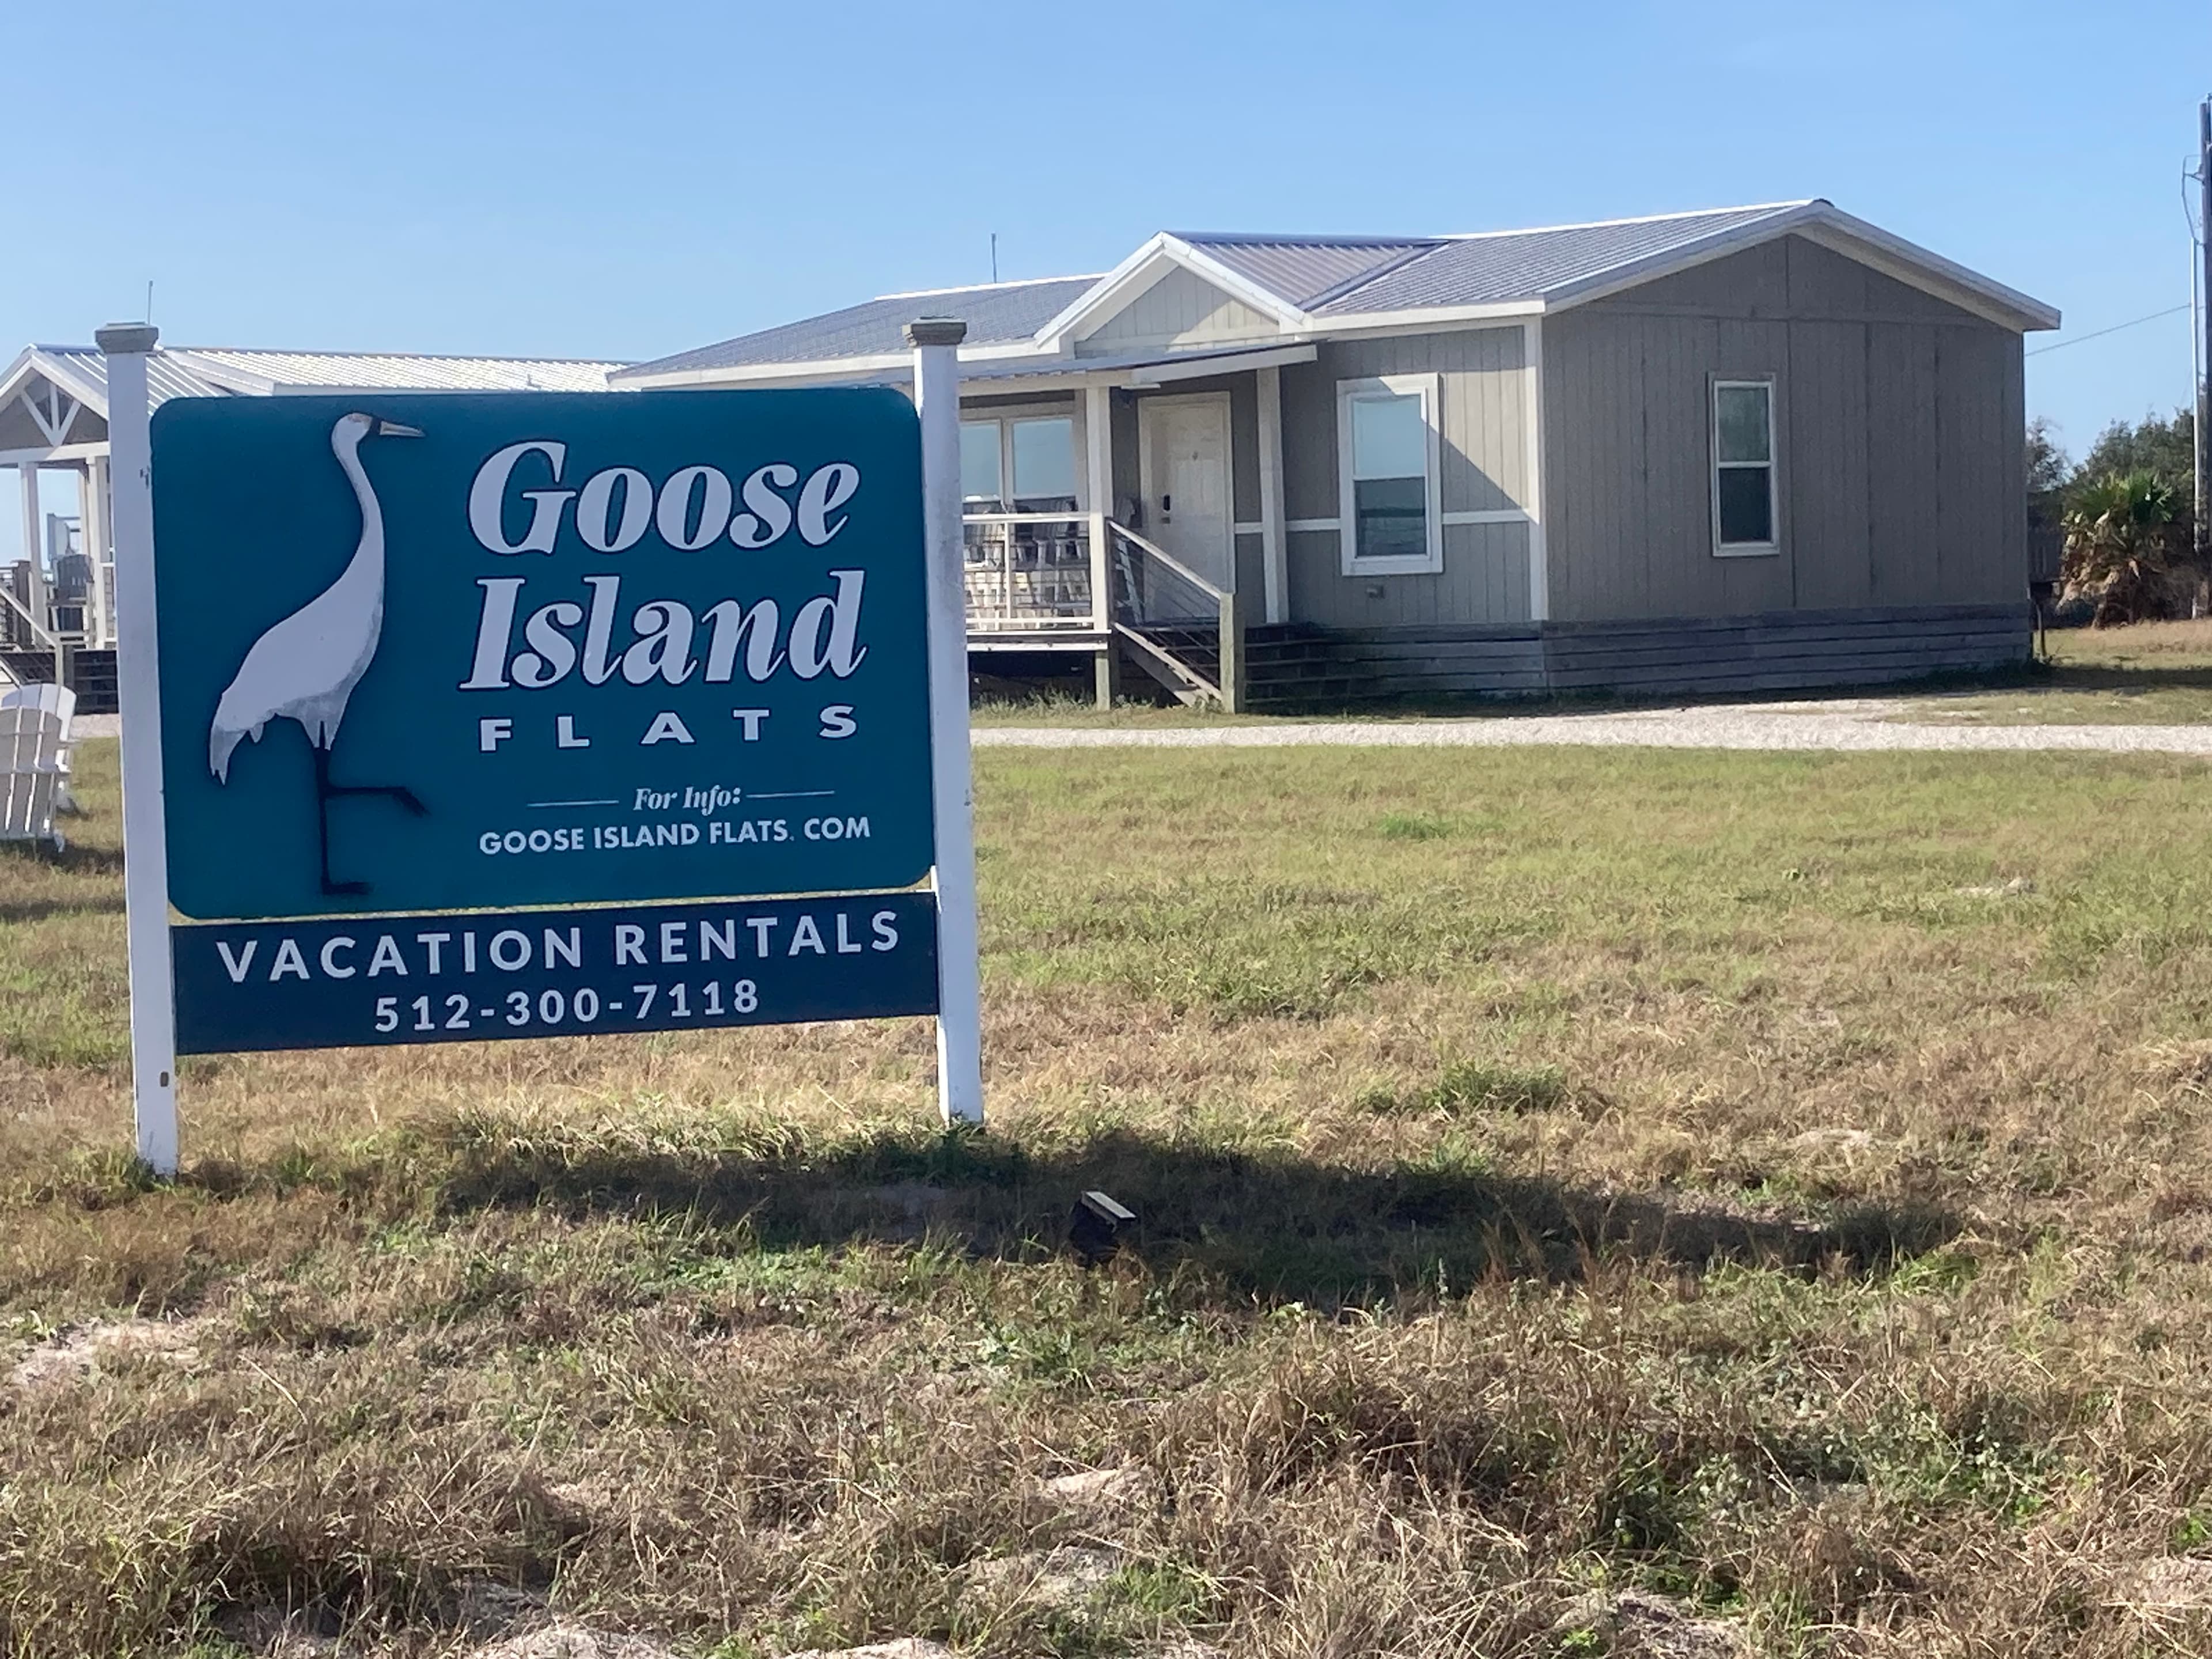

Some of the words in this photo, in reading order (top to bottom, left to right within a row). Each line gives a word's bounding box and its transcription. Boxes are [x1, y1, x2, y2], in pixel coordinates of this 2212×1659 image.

[468, 441, 860, 554] Goose
[459, 570, 868, 690] Island
[480, 704, 857, 752] FLATS
[632, 787, 679, 811] For
[682, 784, 741, 817] Info:
[479, 827, 585, 855] GOOSE
[593, 823, 700, 849] ISLAND
[215, 927, 581, 983] VACATION
[615, 910, 899, 965] RENTALS
[374, 979, 759, 1033] 512-300-7118
